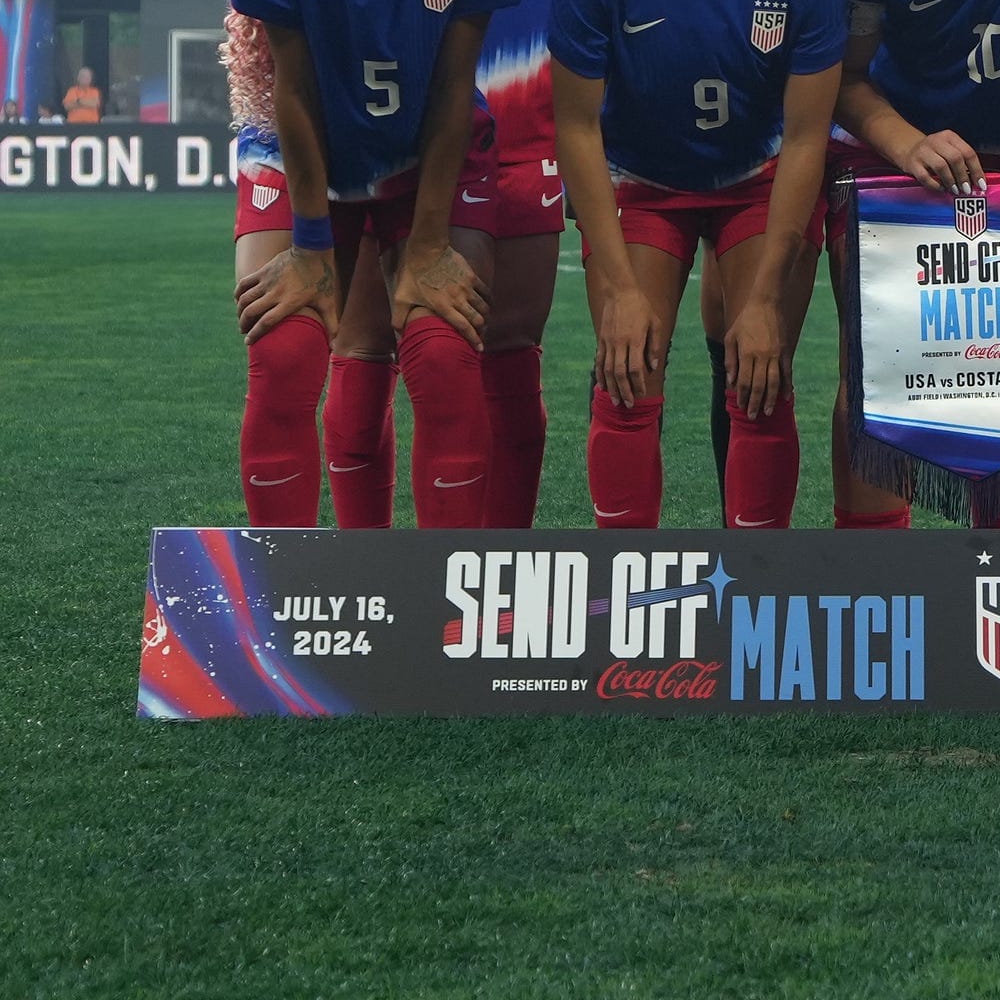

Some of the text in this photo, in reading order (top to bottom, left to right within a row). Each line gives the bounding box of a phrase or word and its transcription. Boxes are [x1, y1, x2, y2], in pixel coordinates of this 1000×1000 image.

[755, 12, 785, 29] USA
[363, 60, 400, 117] 5
[694, 78, 729, 130] 9
[0, 135, 239, 192] GTON, D.
[956, 199, 985, 217] USA
[916, 242, 969, 285] SEND
[905, 373, 936, 389] USA
[273, 596, 394, 625] JULY 16,
[443, 551, 709, 659] SEND OFF
[293, 631, 371, 656] 2024
[730, 595, 925, 701] MATCH
[492, 679, 568, 691] PRESENTED
[571, 679, 588, 691] BY
